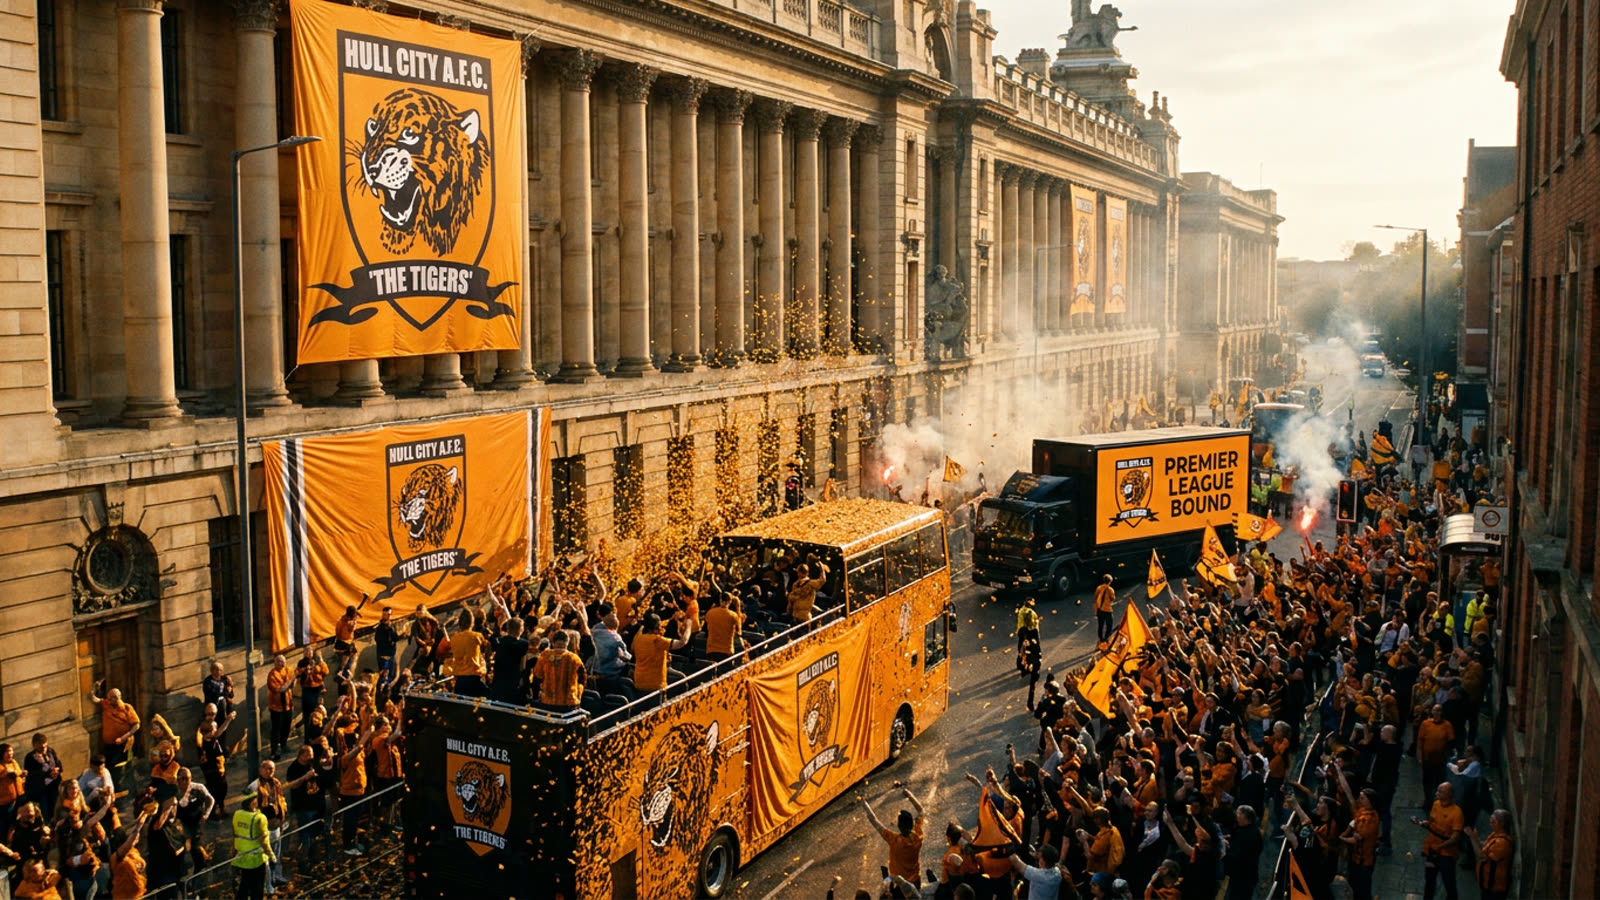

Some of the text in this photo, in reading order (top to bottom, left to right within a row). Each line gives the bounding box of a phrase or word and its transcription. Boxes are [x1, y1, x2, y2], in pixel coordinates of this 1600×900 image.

[344, 38, 488, 90] HULL CITY A.F.C.
[415, 442, 438, 459] CITY
[1164, 451, 1238, 475] PREMIER
[1168, 471, 1234, 496] LEAGUE
[1171, 493, 1232, 517] BOUND
